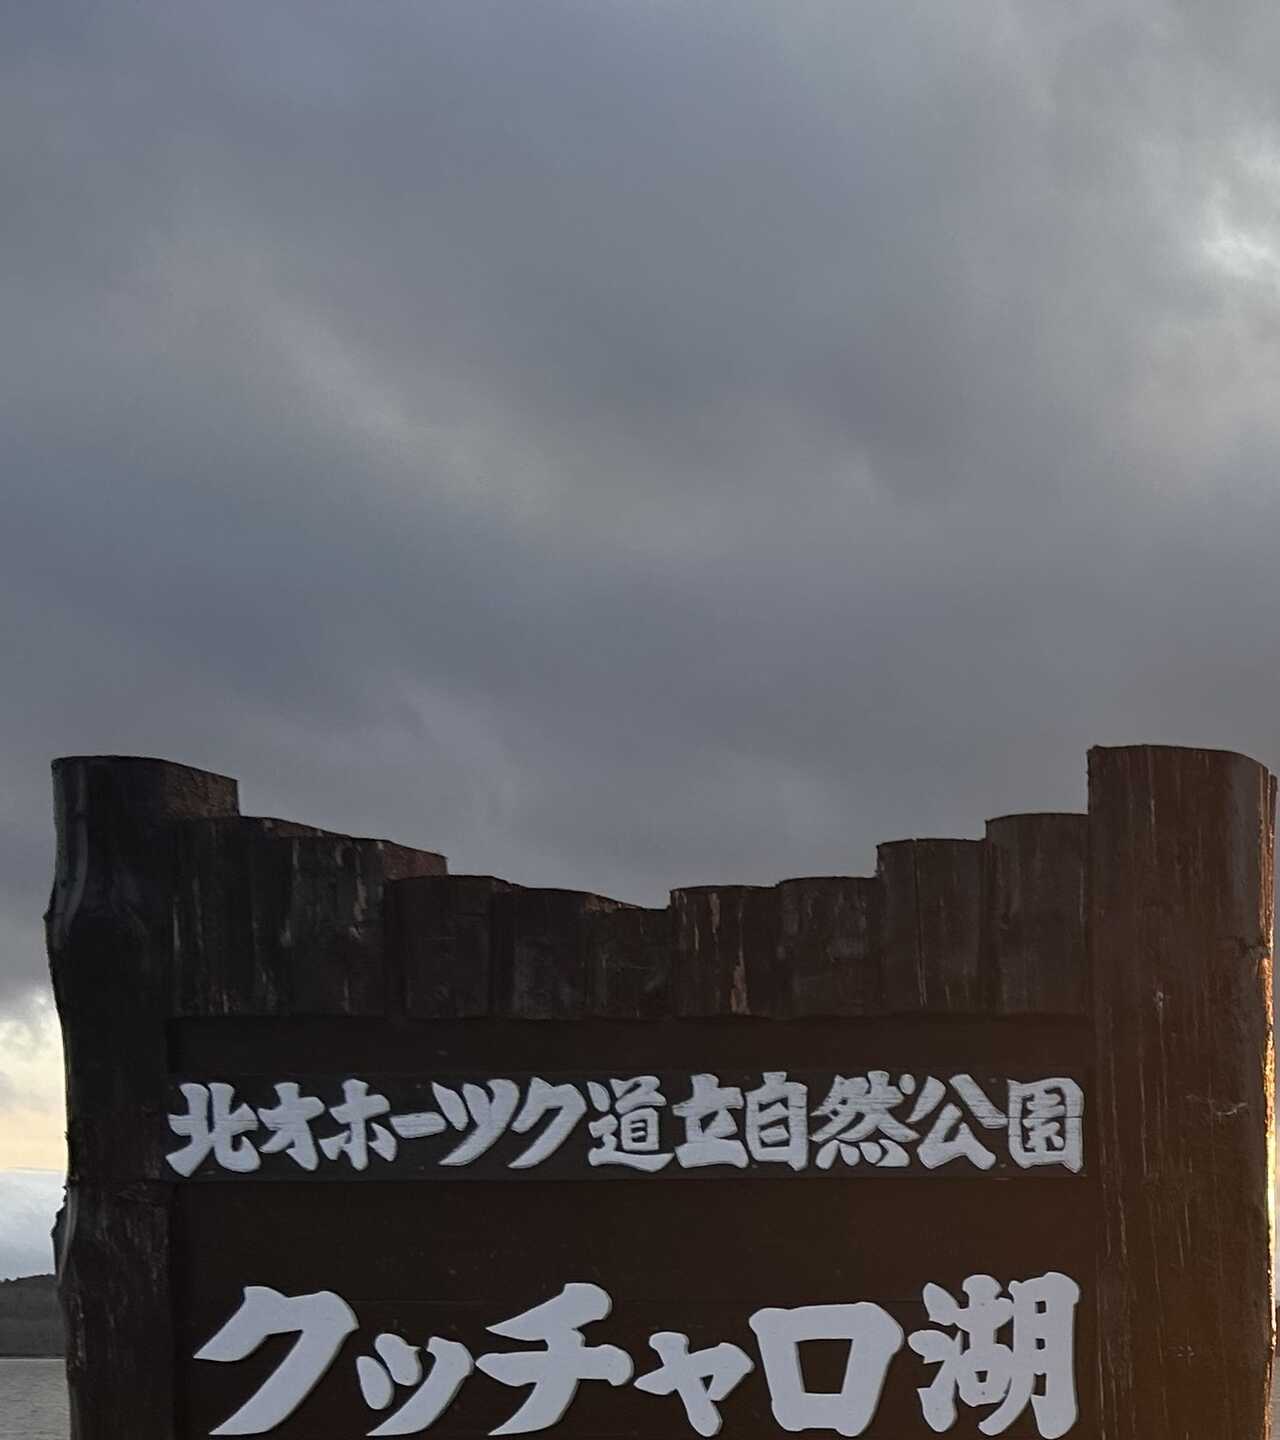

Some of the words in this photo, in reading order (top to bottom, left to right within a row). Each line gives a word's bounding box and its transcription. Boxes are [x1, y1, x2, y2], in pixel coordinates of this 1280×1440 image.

[166, 1071, 1083, 1175] 北オホーツク道立自然公園
[194, 1272, 1080, 1439] クッチャロ湖
